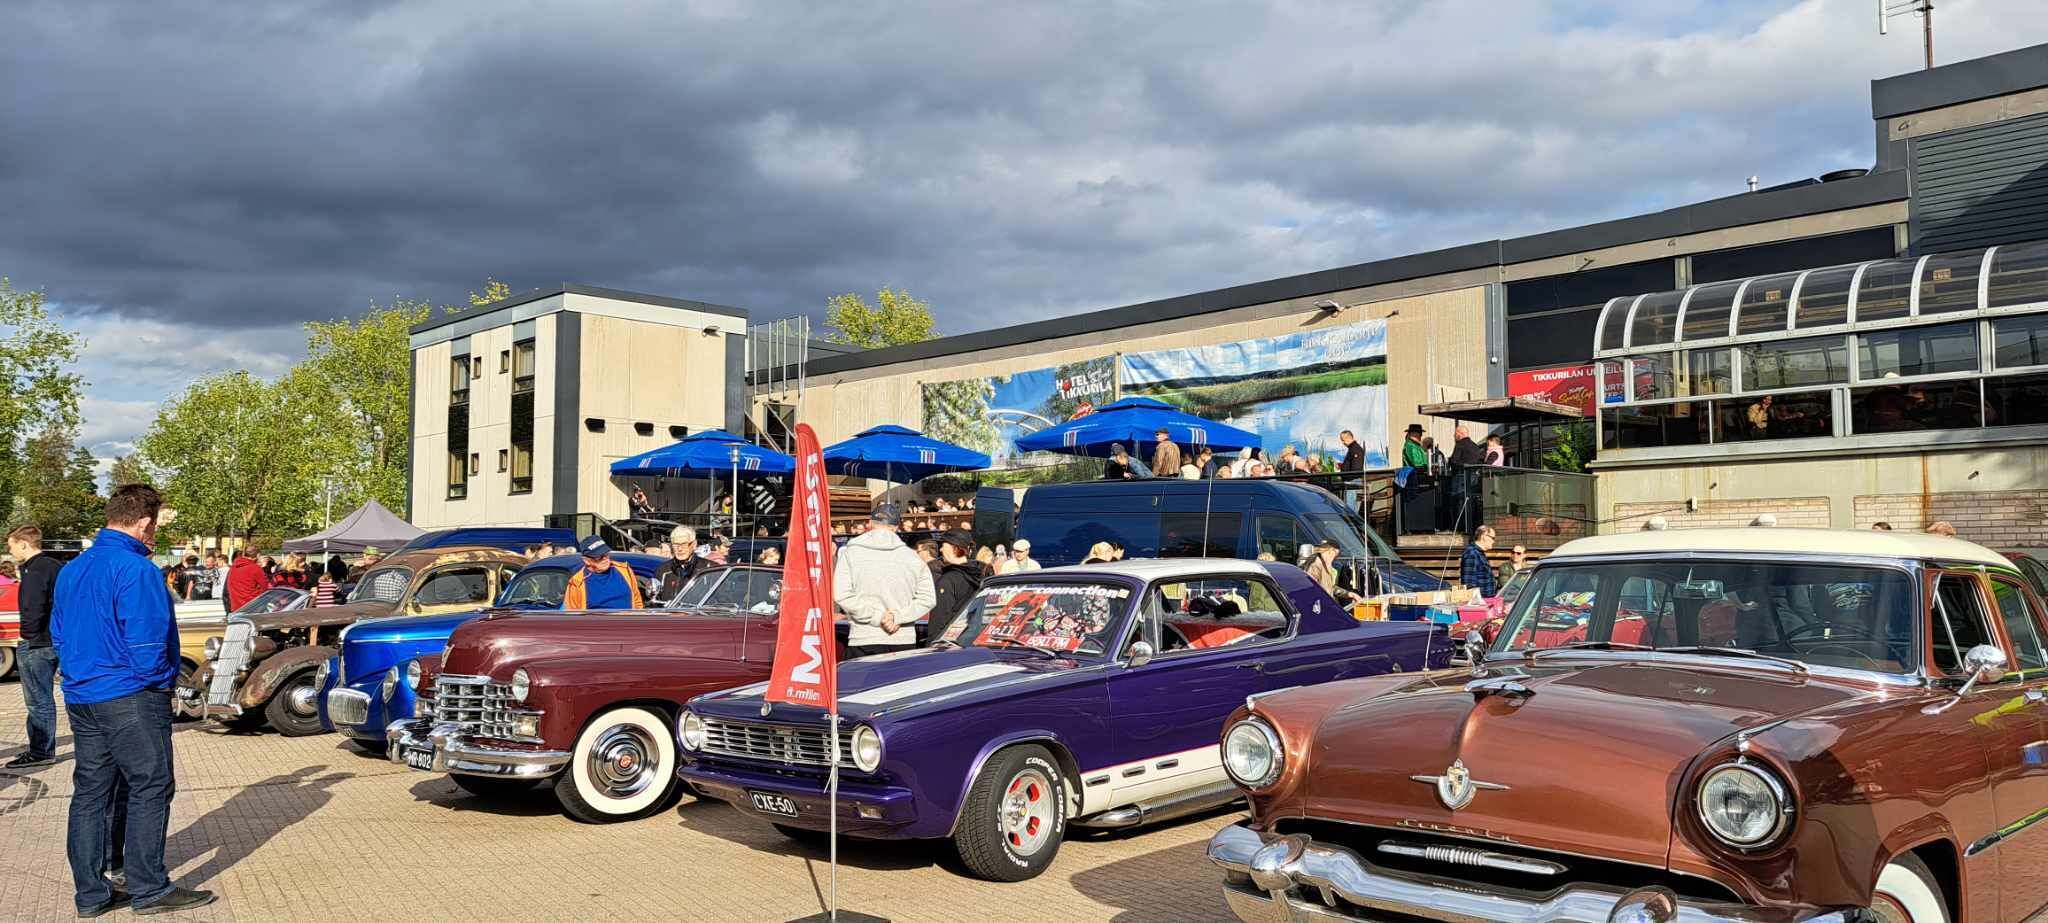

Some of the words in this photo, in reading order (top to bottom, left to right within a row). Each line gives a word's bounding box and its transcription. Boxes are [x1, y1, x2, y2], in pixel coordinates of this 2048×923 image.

[1532, 369, 1583, 381] TIKKURILAN
[753, 794, 793, 813] CXE-50
[1025, 757, 1058, 781] COOPER
[1056, 785, 1064, 833] COBRA
